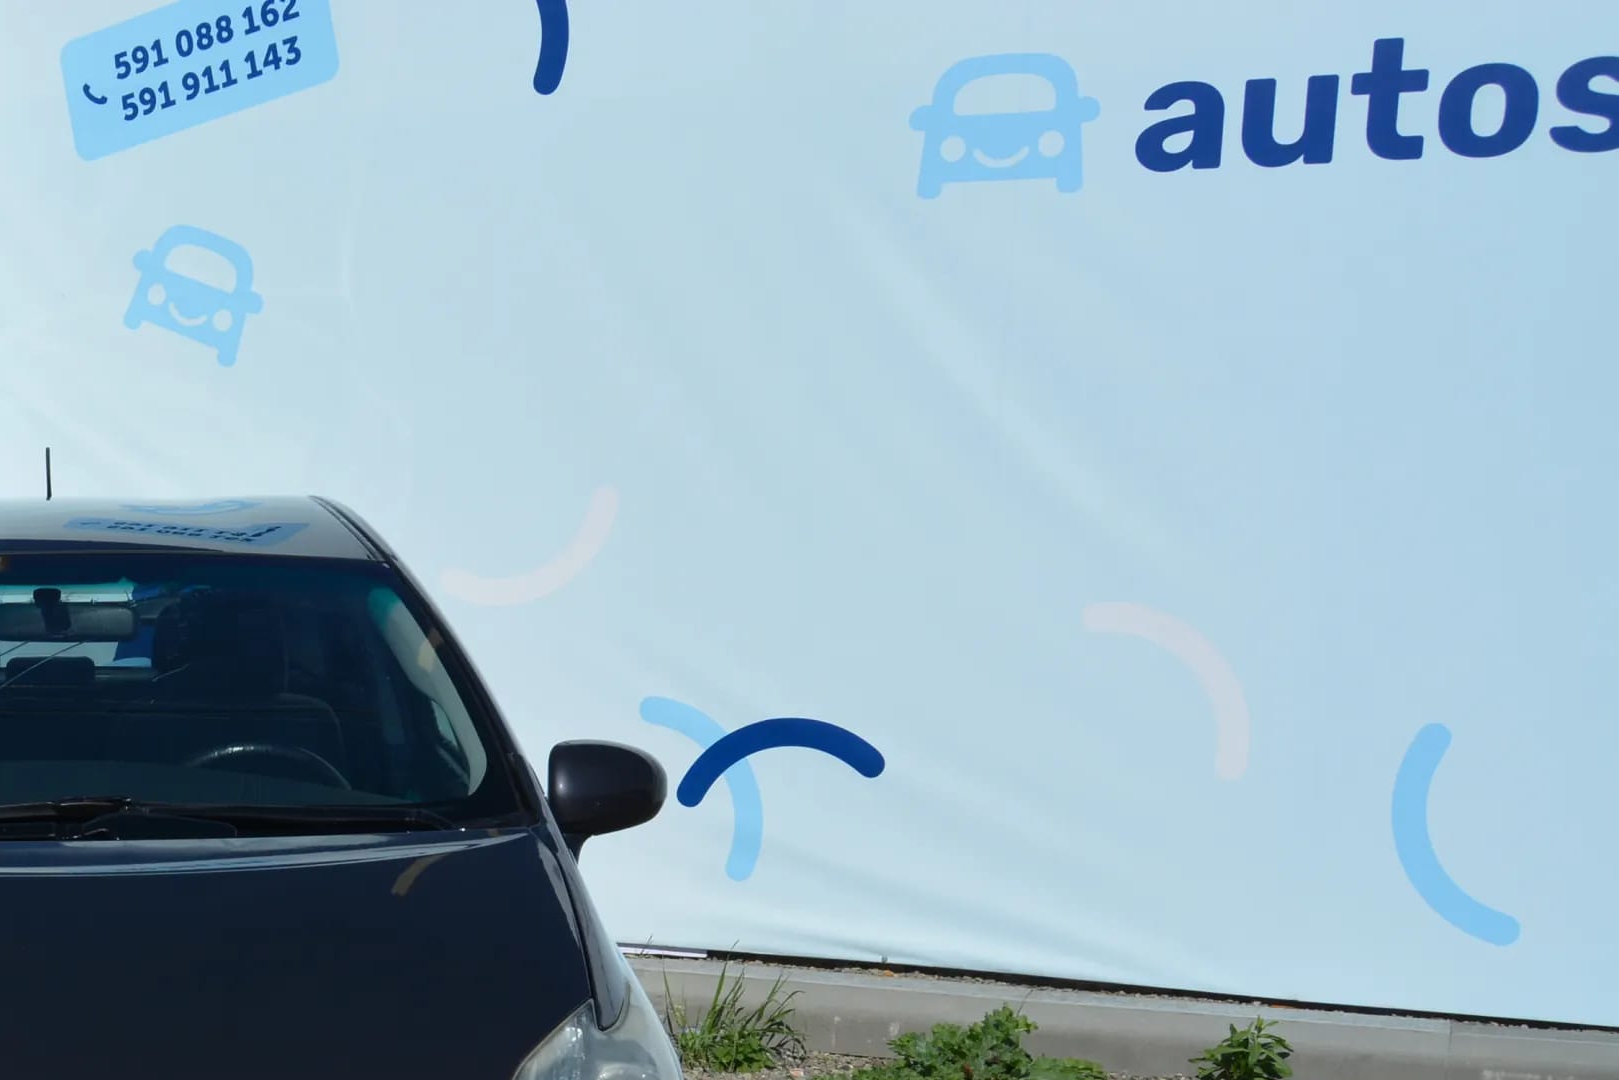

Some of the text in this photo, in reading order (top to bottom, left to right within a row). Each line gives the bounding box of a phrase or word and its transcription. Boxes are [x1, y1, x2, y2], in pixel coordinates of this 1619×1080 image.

[114, 0, 300, 80] 591 088 162
[121, 35, 301, 121] 591 911 143
